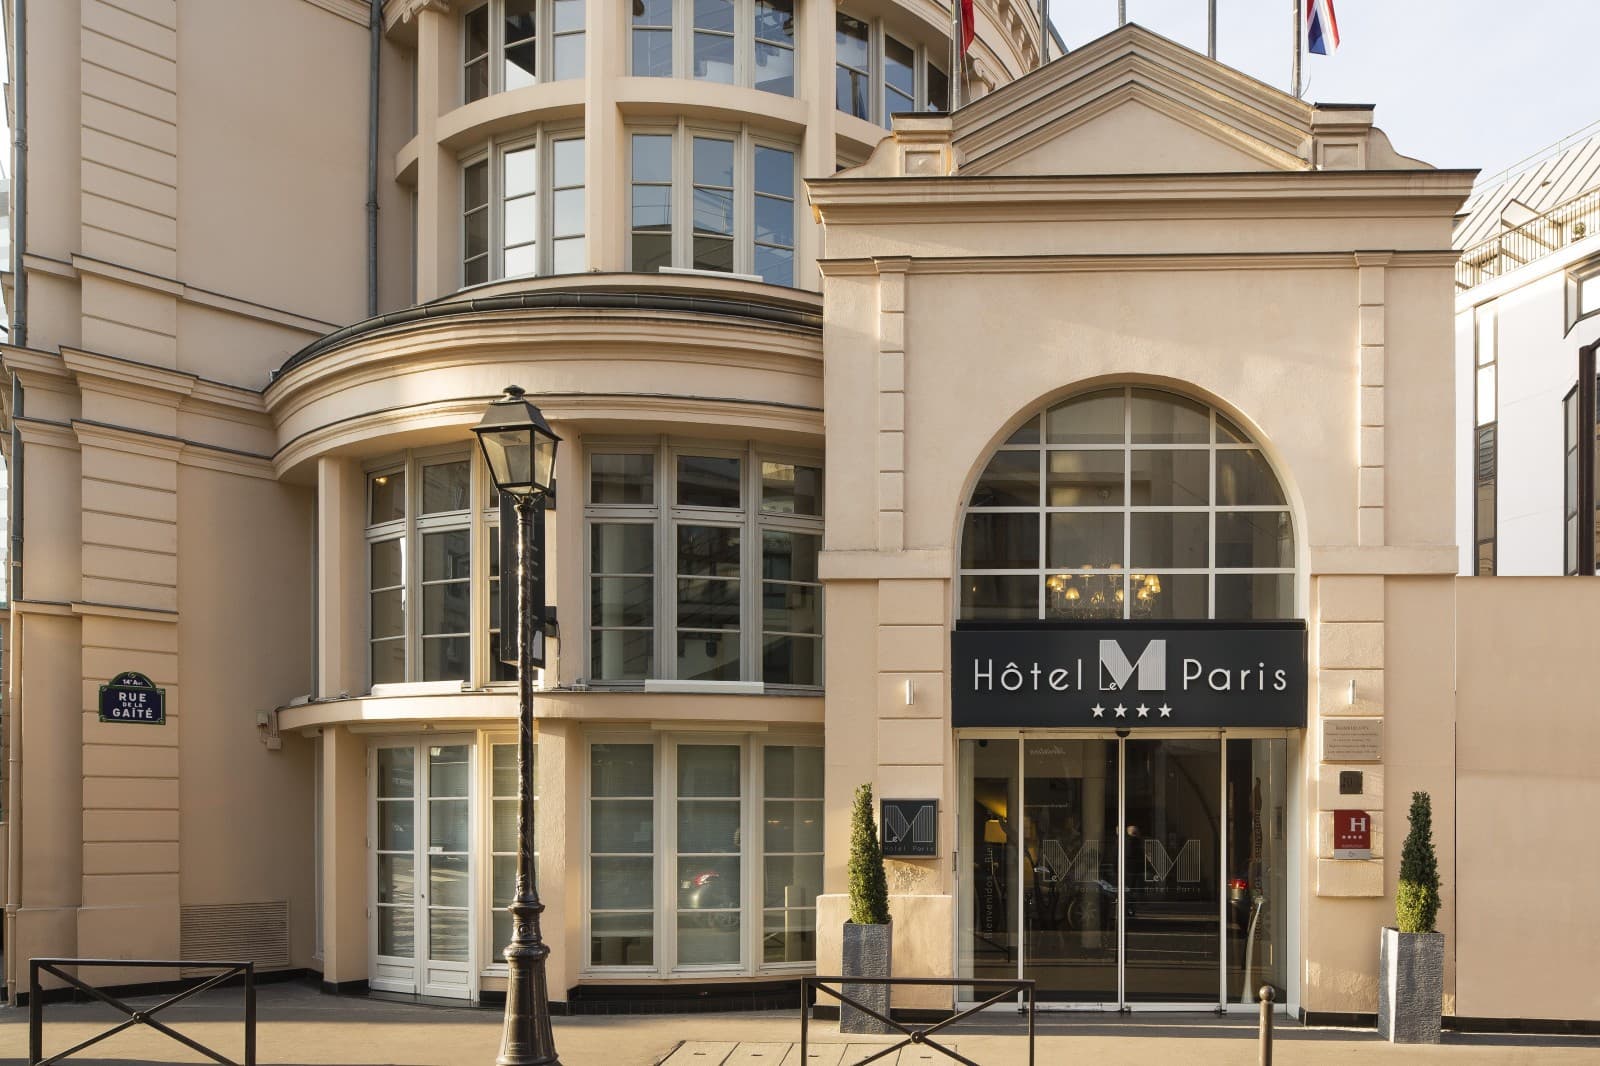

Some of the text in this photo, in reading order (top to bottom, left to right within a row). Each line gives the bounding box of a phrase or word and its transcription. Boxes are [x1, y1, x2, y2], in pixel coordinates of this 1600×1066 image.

[974, 658, 1082, 691] Hôtel
[1183, 658, 1287, 691] Paris
[119, 692, 147, 702] RUE
[112, 707, 153, 719] GAÎTÉ
[1350, 817, 1366, 832] H
